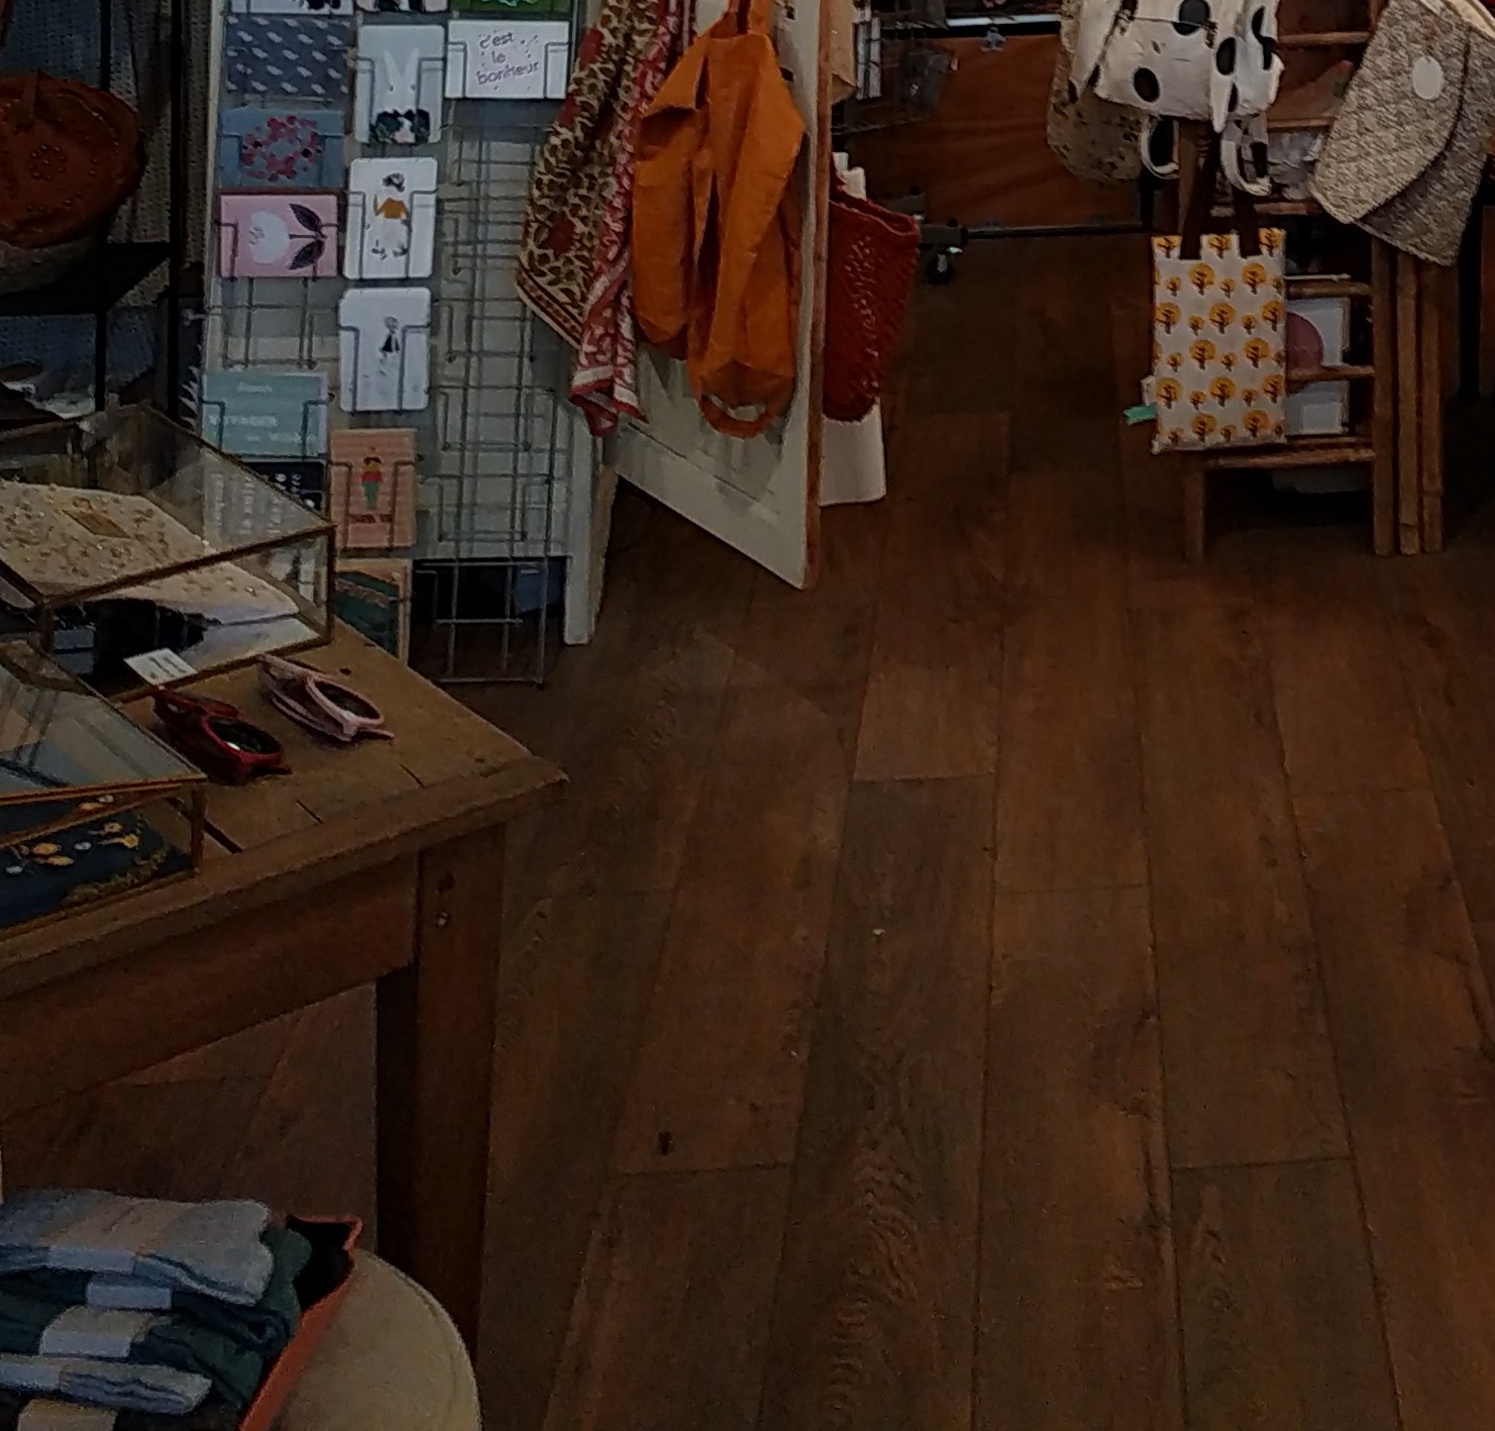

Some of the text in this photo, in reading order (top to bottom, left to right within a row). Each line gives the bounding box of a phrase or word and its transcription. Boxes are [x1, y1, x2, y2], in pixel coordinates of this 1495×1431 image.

[479, 31, 514, 49] c'est
[491, 50, 507, 64] le
[476, 61, 540, 86] bonheur
